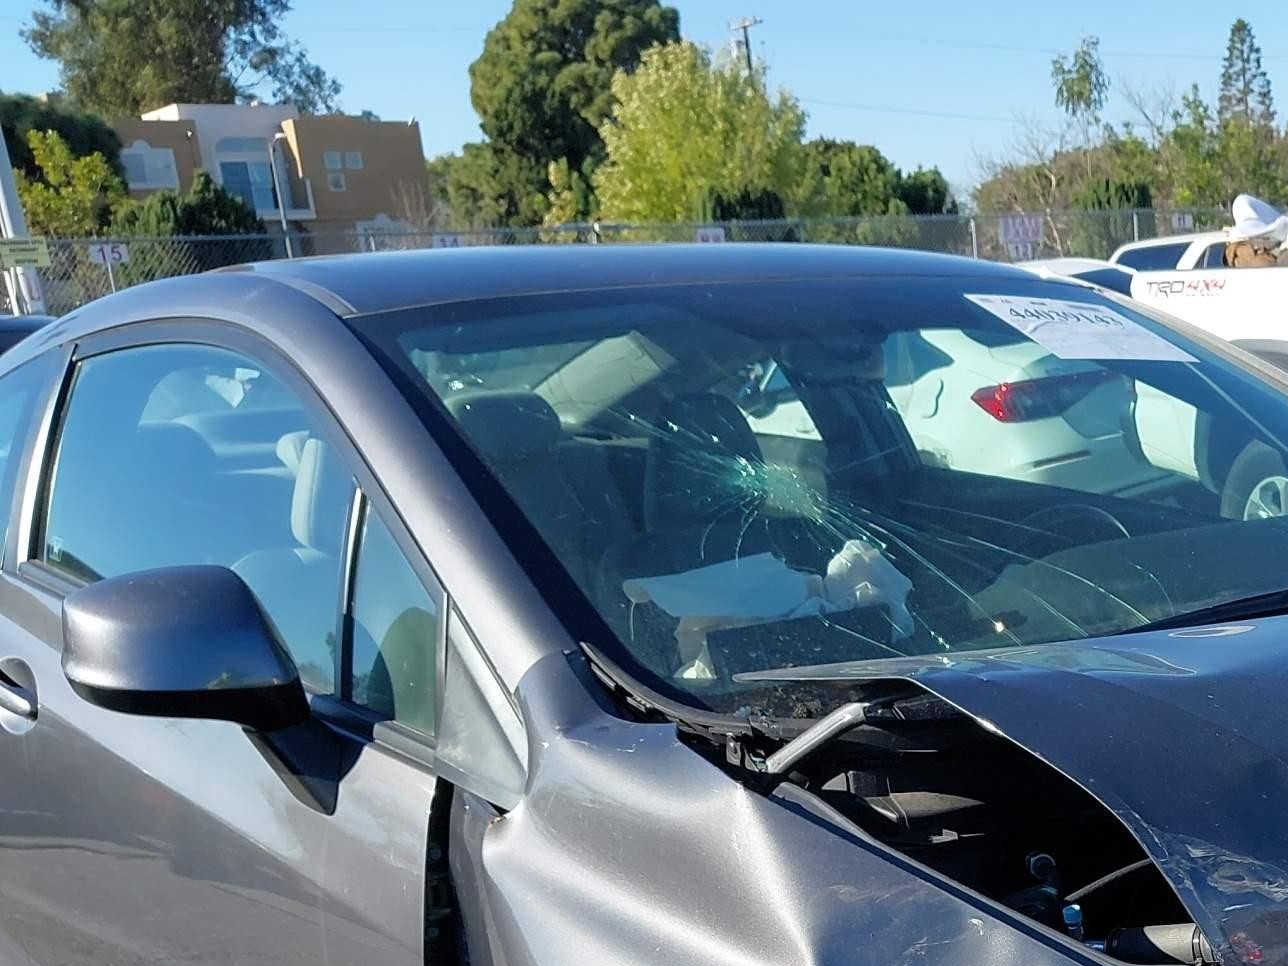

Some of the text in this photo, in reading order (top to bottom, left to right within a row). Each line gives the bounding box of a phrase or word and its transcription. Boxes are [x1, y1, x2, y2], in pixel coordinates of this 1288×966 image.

[97, 244, 123, 263] 15
[1146, 280, 1185, 299] TRD
[1008, 307, 1125, 328] 44039143
